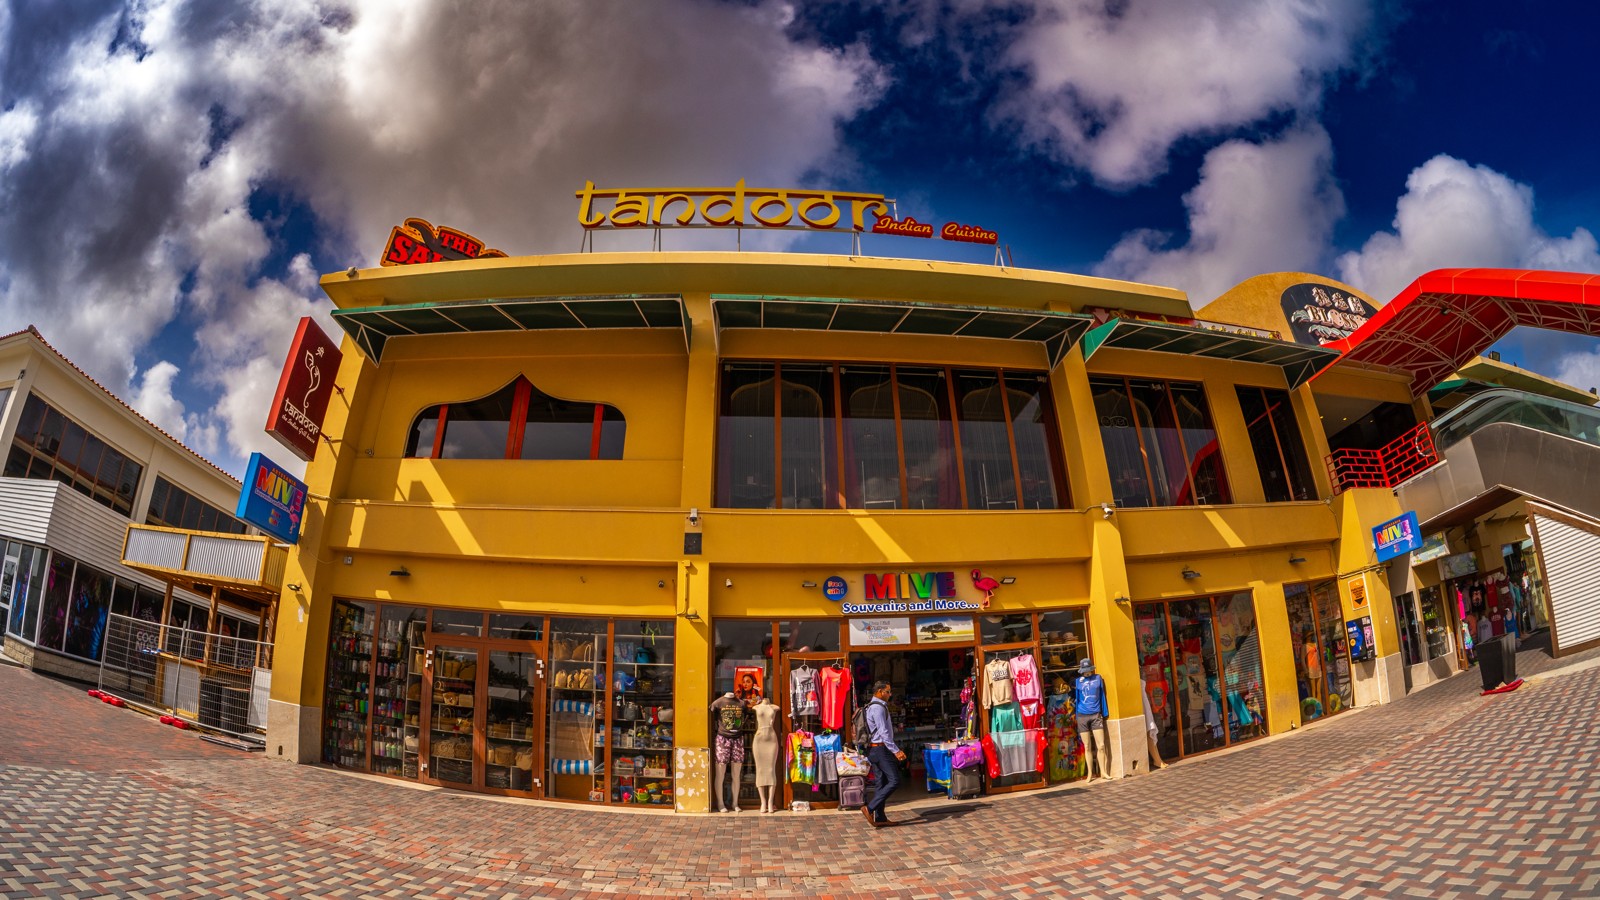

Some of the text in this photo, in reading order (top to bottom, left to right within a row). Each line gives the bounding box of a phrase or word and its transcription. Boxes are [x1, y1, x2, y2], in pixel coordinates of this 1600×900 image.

[576, 178, 888, 230] tandoor
[875, 216, 998, 242] Indian Cuisine
[441, 232, 478, 258] THE
[284, 397, 319, 435] tandoor
[255, 465, 304, 512] MIVE
[1375, 519, 1411, 546] MIVE
[863, 571, 956, 600] MIVE
[842, 600, 906, 614] Souvenirs
[909, 600, 933, 611] and
